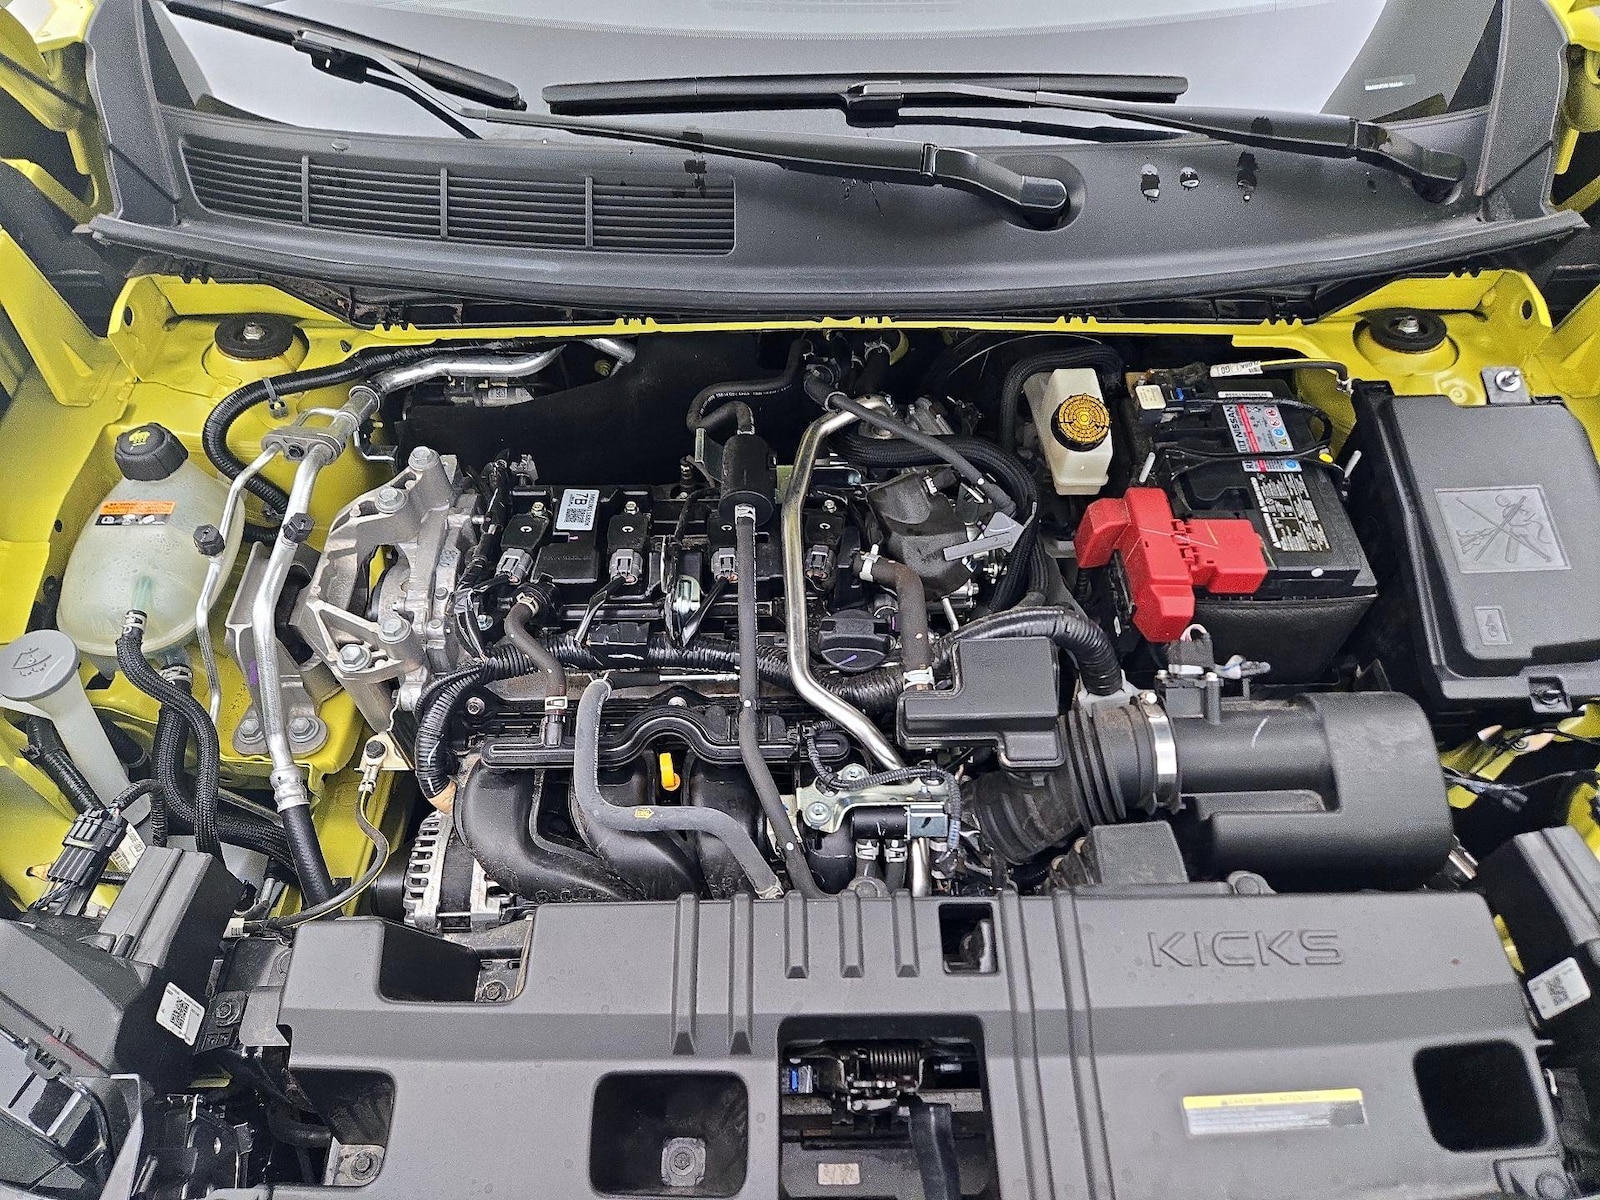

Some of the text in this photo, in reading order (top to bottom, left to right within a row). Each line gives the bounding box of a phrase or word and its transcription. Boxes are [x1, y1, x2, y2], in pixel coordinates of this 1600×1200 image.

[1225, 405, 1243, 438] NISSAN
[574, 493, 588, 505] 7B
[1147, 929, 1344, 967] KICKS
